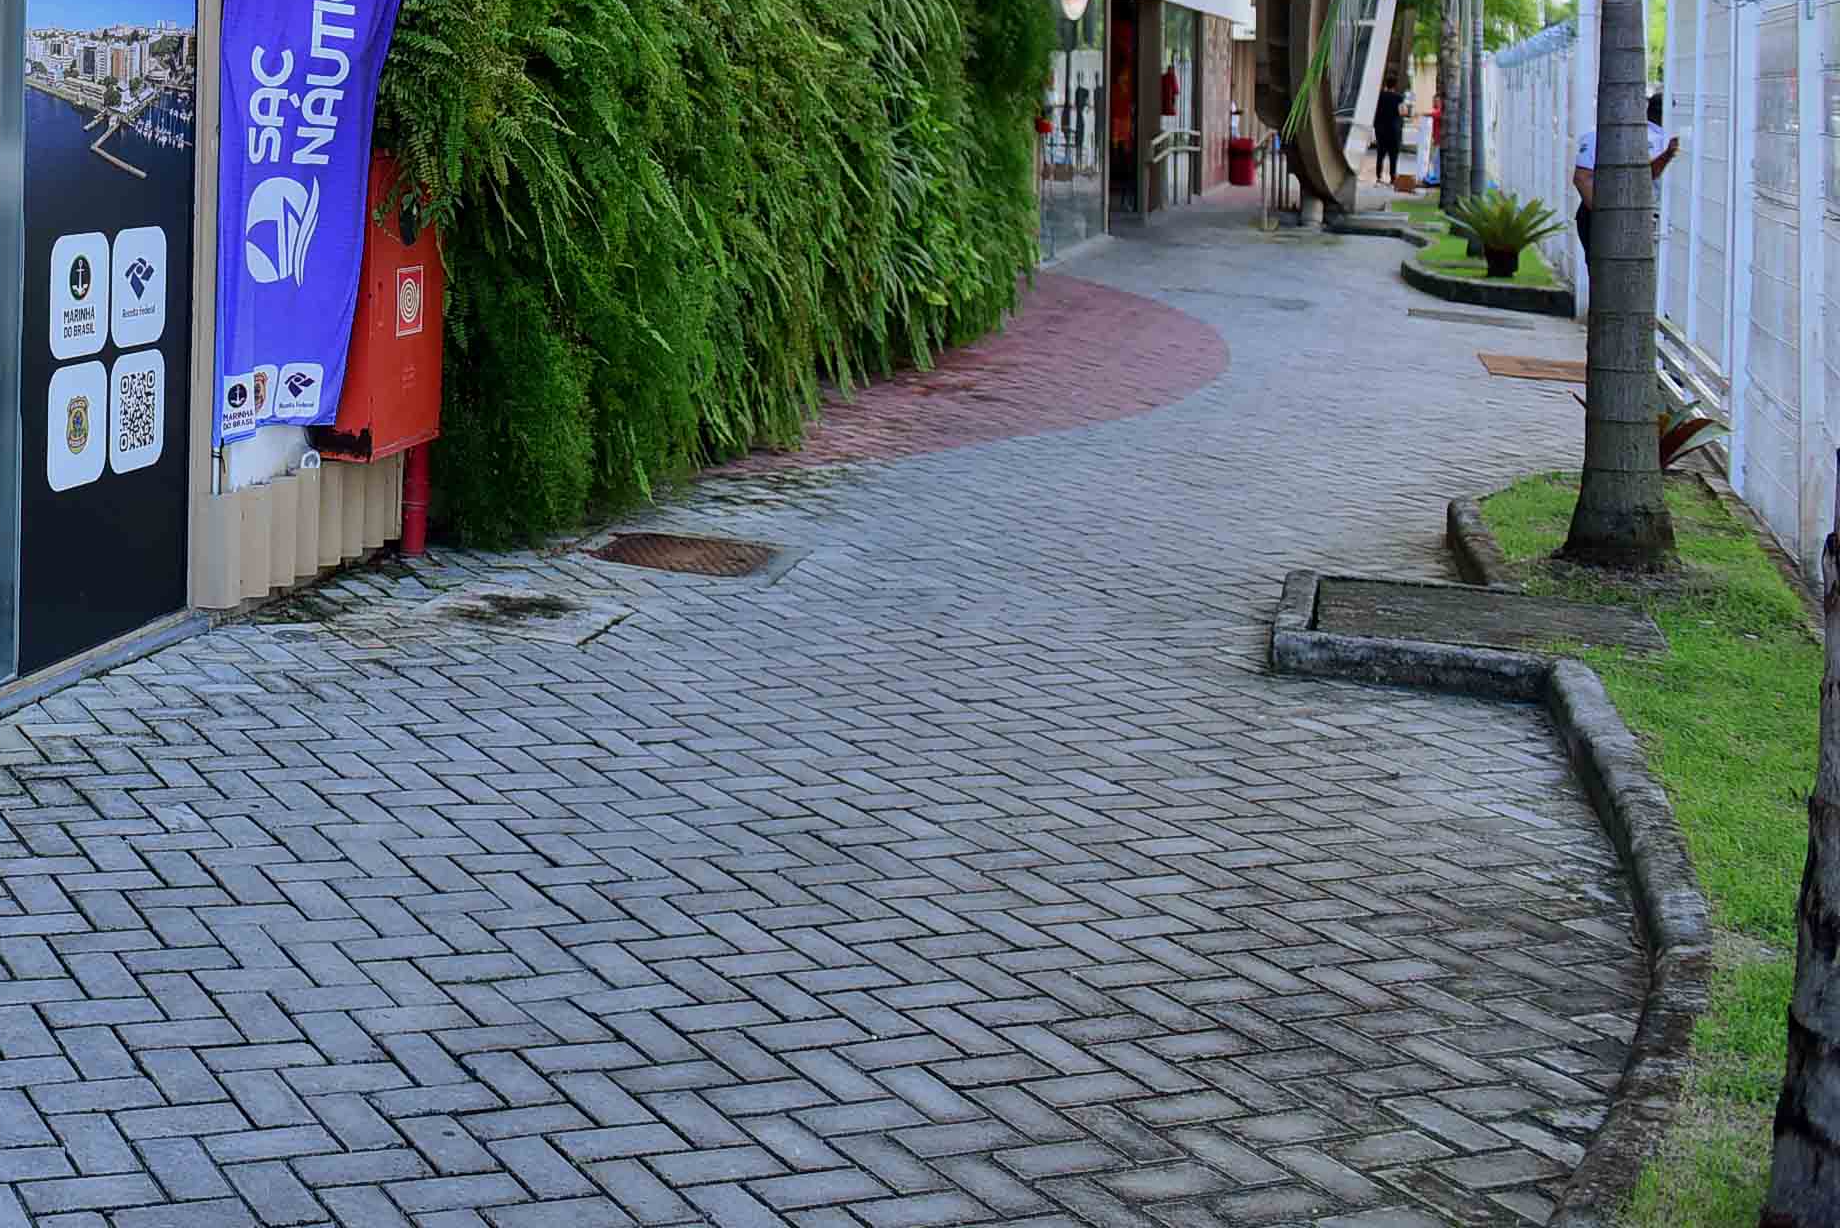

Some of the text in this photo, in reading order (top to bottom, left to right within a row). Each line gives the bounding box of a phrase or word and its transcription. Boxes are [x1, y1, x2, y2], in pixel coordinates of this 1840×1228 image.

[248, 45, 294, 164] SAC
[63, 305, 95, 325] MARINHA
[63, 323, 96, 339] DO BRASIL
[223, 409, 254, 422] MARINHA
[232, 418, 254, 428] BRASIL
